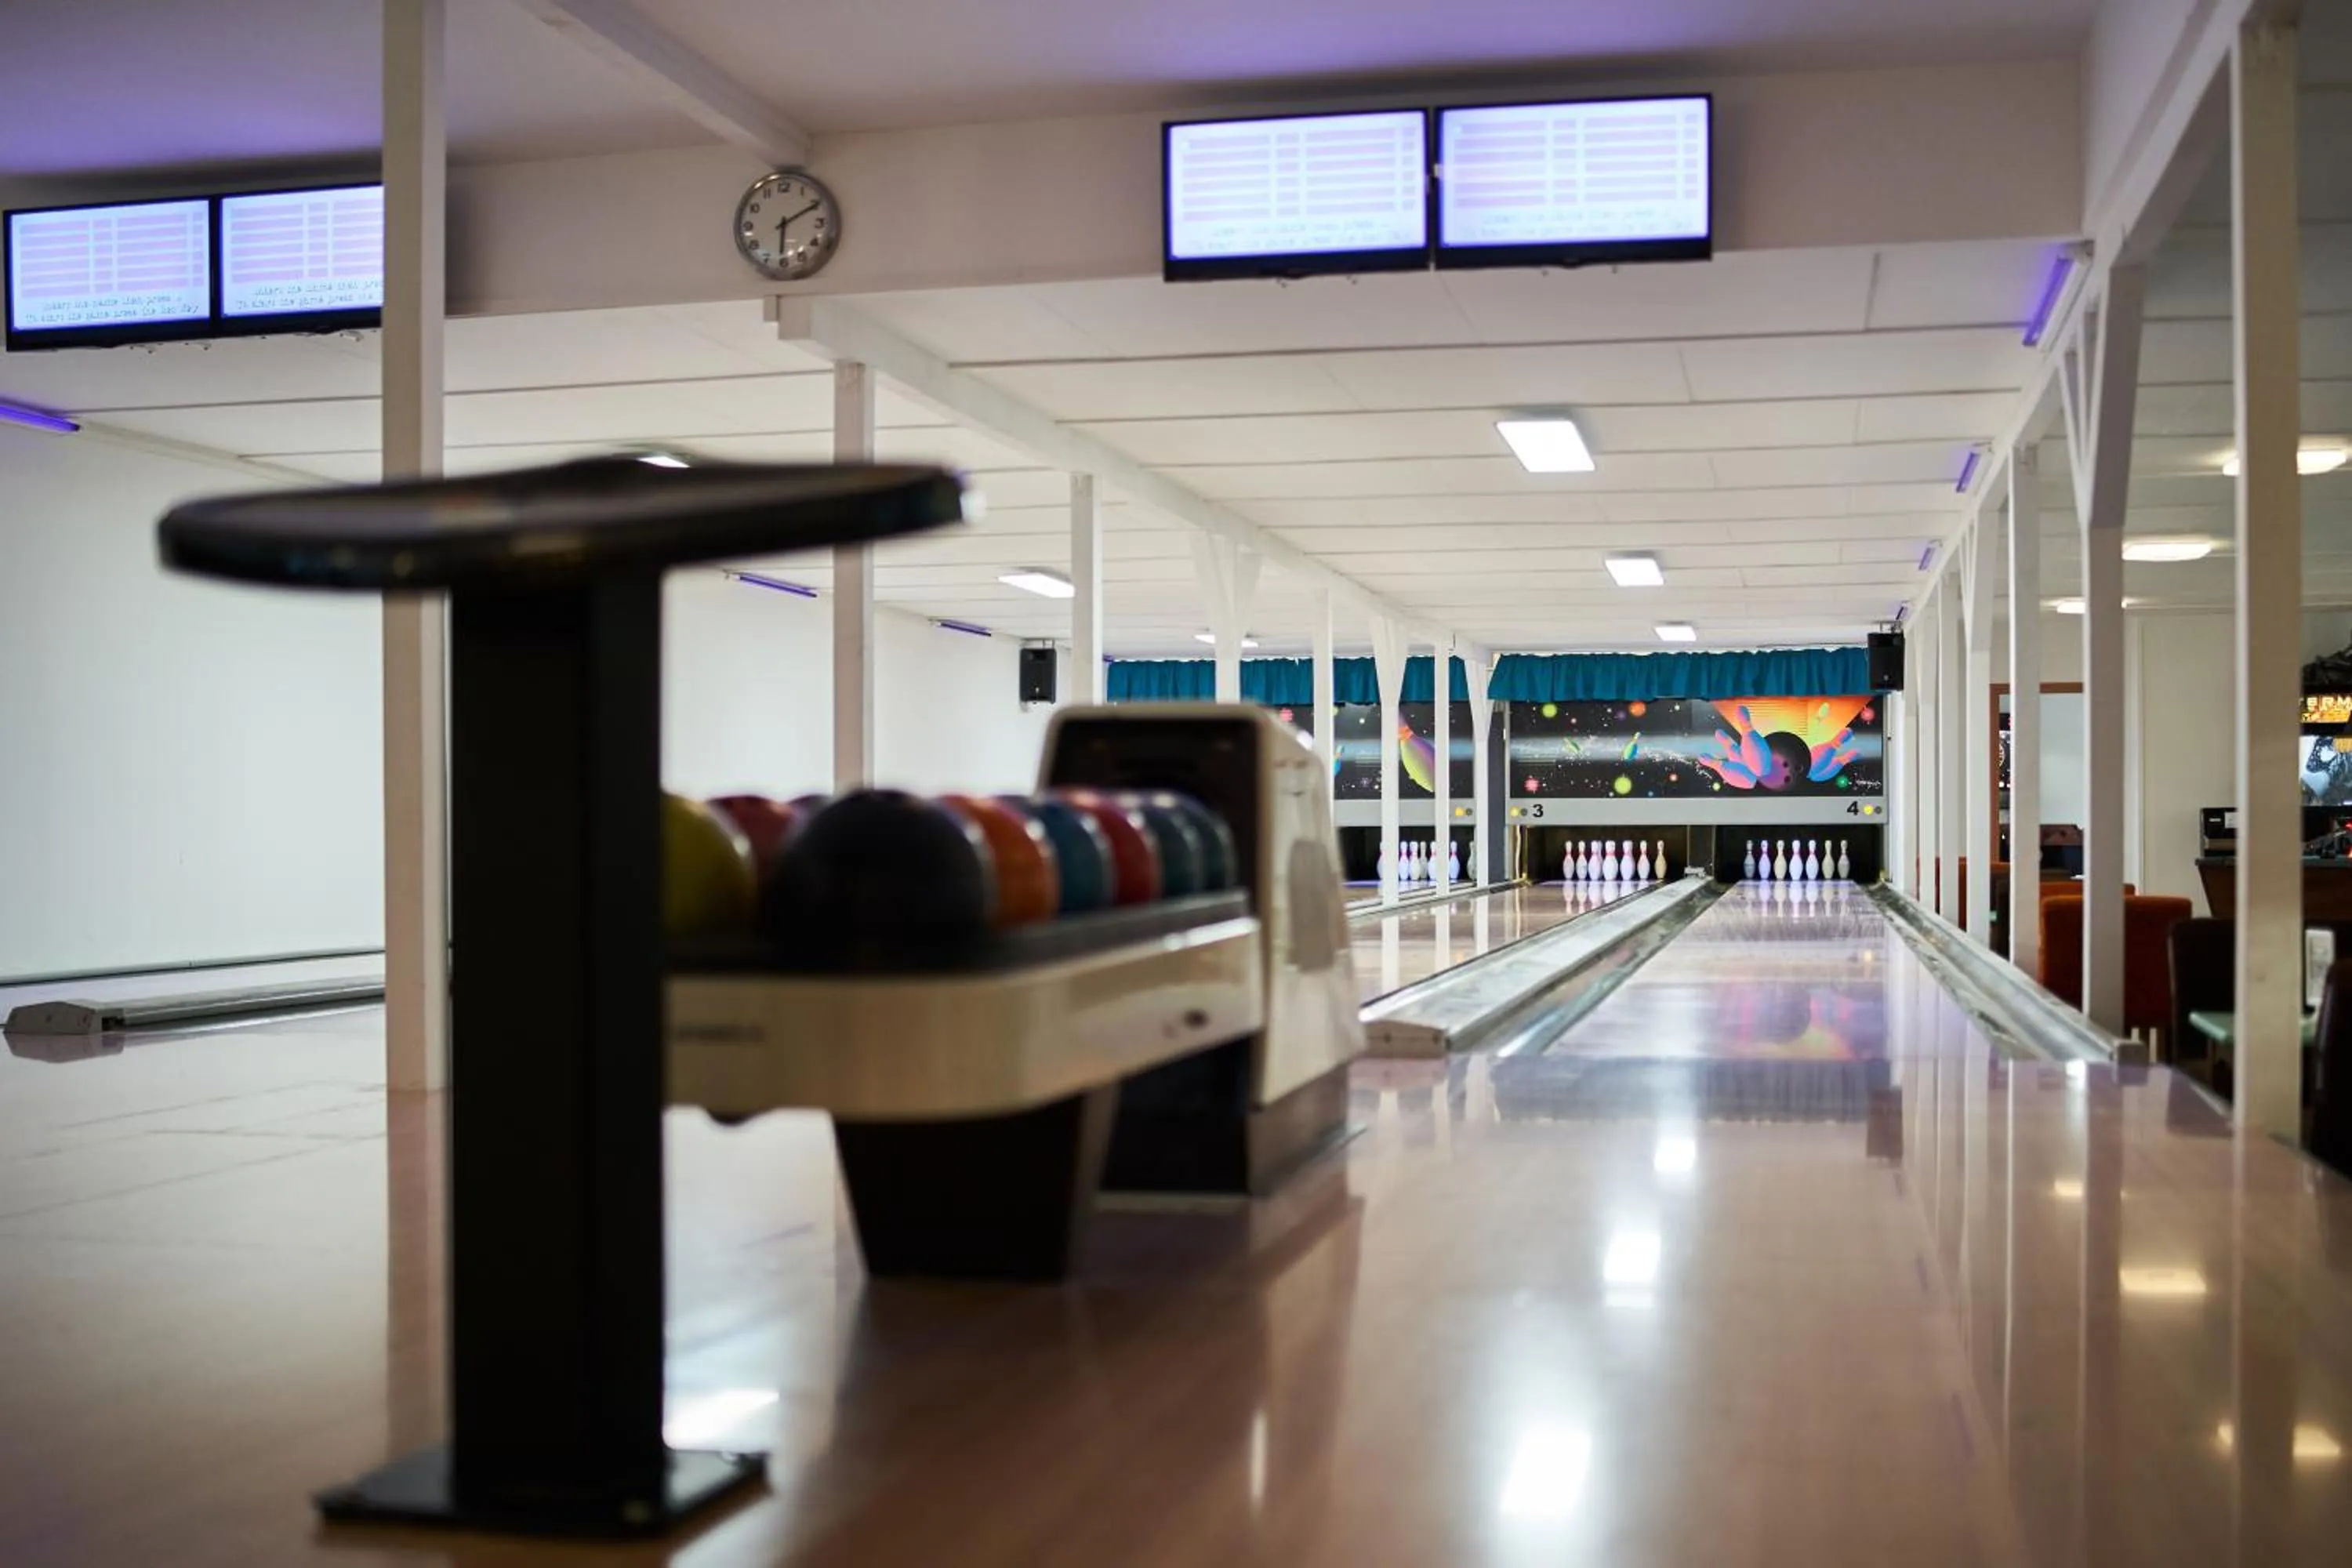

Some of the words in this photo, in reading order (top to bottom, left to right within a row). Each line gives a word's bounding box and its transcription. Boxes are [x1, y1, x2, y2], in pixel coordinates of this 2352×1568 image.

[763, 187, 771, 199] 11
[778, 183, 790, 193] 12
[750, 202, 760, 213] 10
[743, 221, 753, 231] 9
[815, 218, 825, 229] 3
[749, 240, 760, 250] 8
[810, 238, 818, 247] 4
[779, 257, 789, 267] 6
[1533, 804, 1544, 817] 3
[1846, 800, 1859, 815] 4
